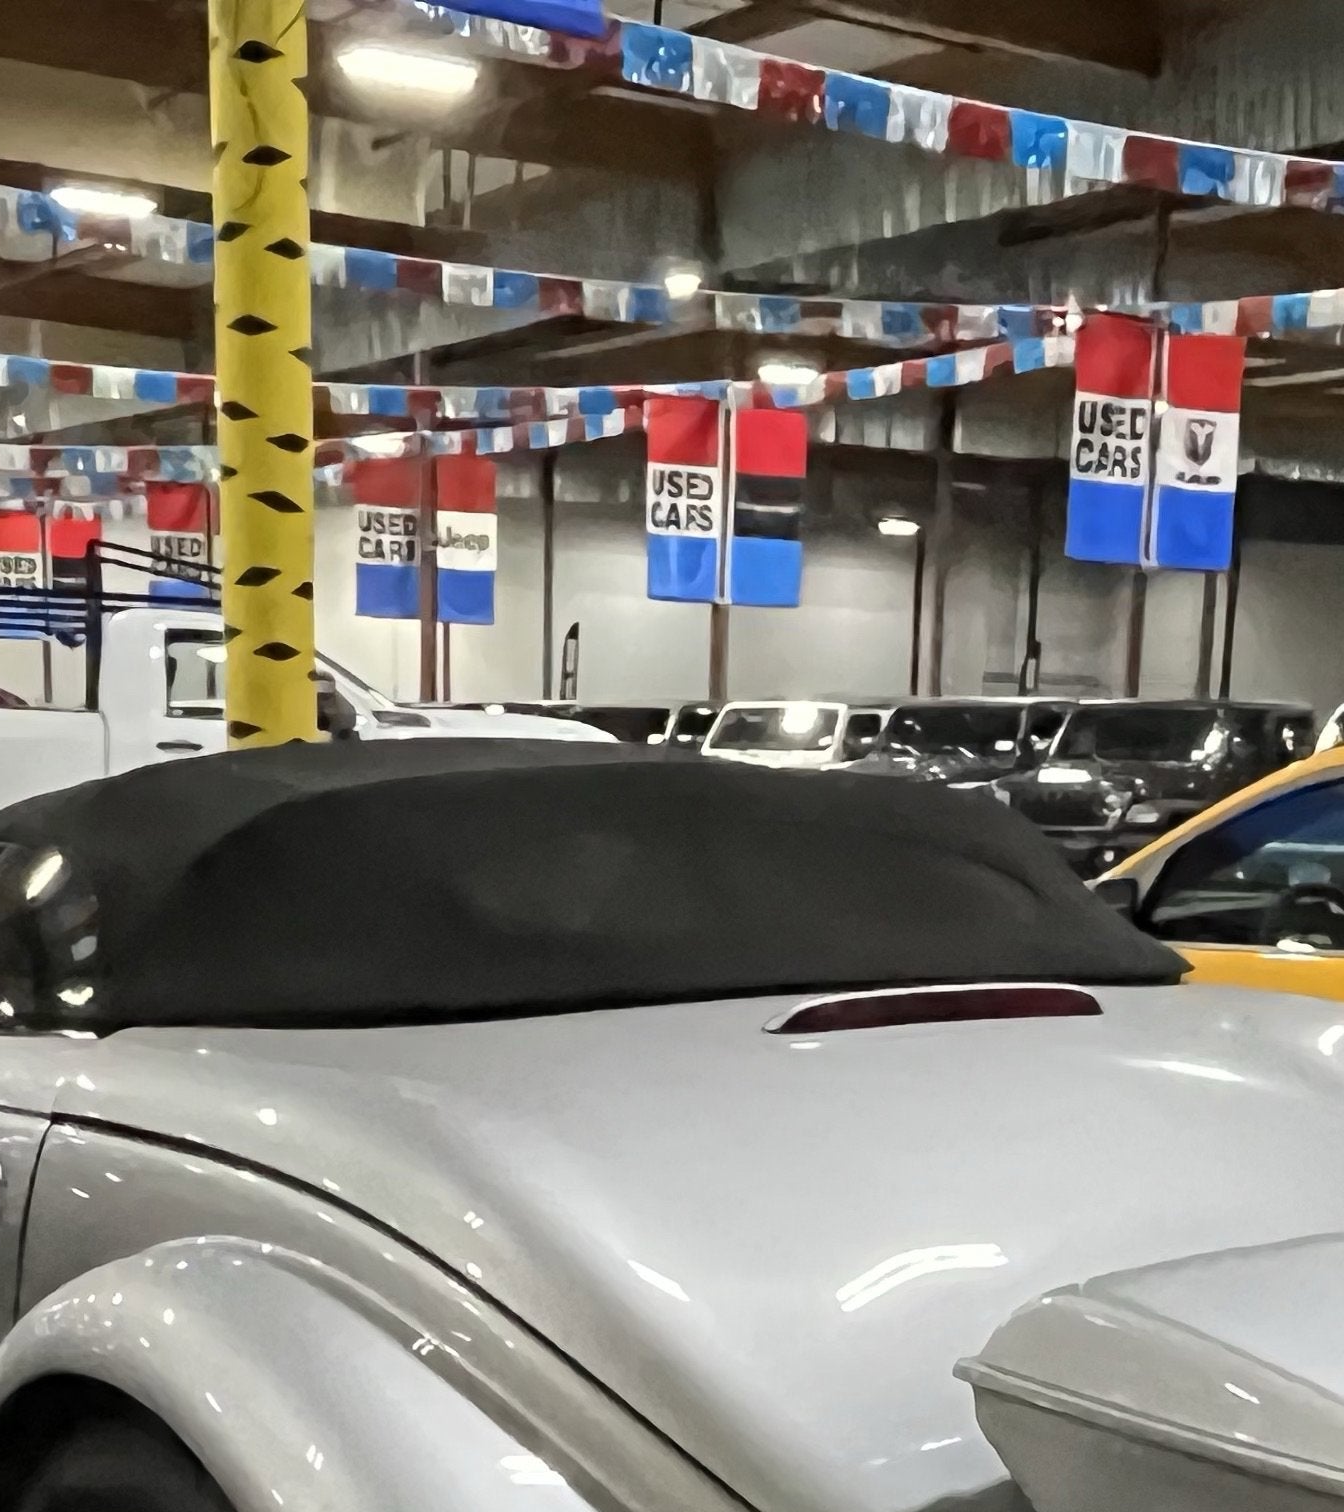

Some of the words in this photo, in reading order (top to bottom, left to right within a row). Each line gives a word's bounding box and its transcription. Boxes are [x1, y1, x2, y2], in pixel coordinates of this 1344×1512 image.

[1078, 400, 1147, 440] USED
[1075, 438, 1142, 479] CARS
[652, 470, 714, 500] USED
